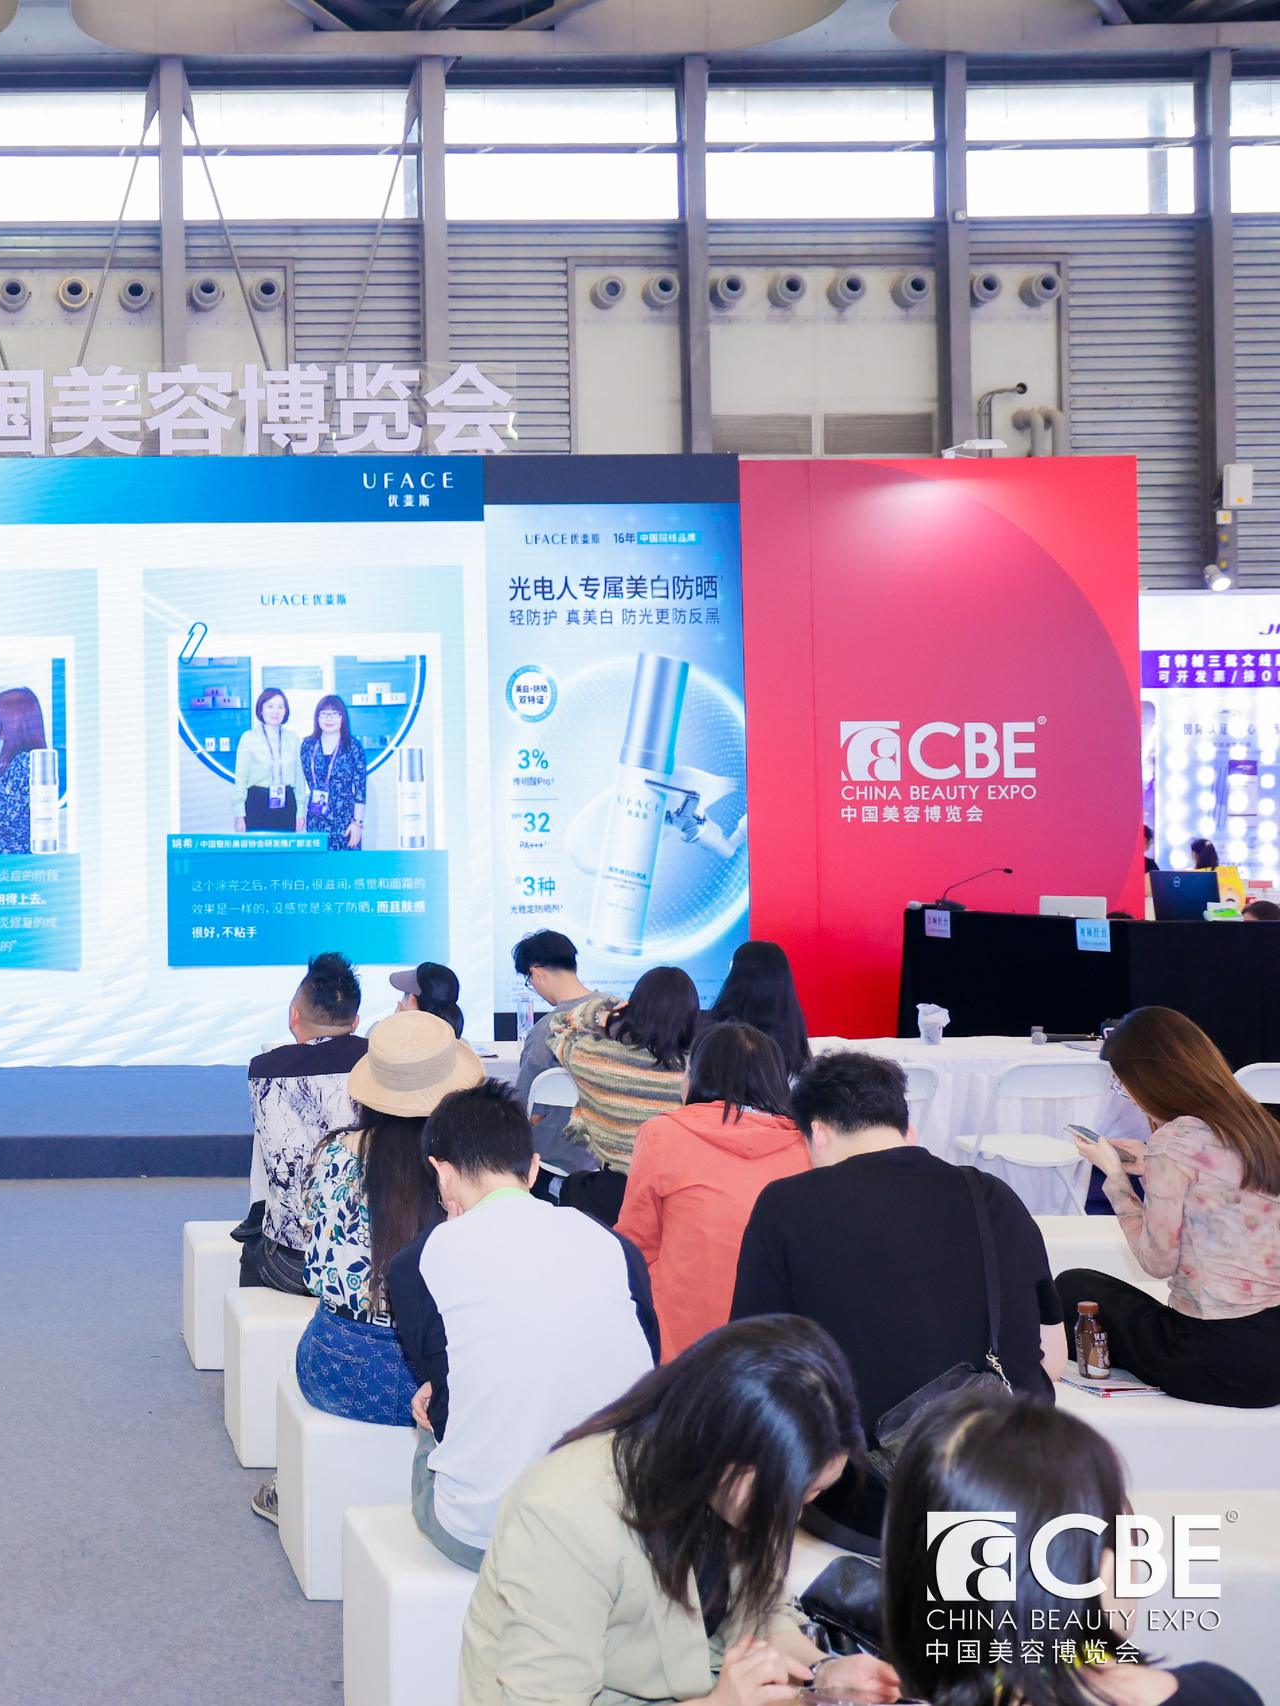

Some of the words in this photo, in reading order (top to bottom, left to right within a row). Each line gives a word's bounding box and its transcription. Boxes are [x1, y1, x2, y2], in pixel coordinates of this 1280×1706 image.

[363, 473, 455, 489] UFACE
[525, 533, 568, 545] UFACE
[614, 532, 636, 544] 16年
[508, 575, 719, 602] 光电人专属美白防晒
[260, 594, 309, 606] UFACE
[509, 609, 558, 626] 轻防护
[566, 608, 614, 626] 真美白
[621, 607, 721, 625] 防光更防反黑
[518, 748, 549, 770] 3%
[841, 785, 902, 800] CHINA
[910, 785, 980, 800] BEAUTY
[988, 784, 1037, 800] EXPO
[523, 812, 551, 833] 32
[841, 805, 983, 823] 中国美容博览会
